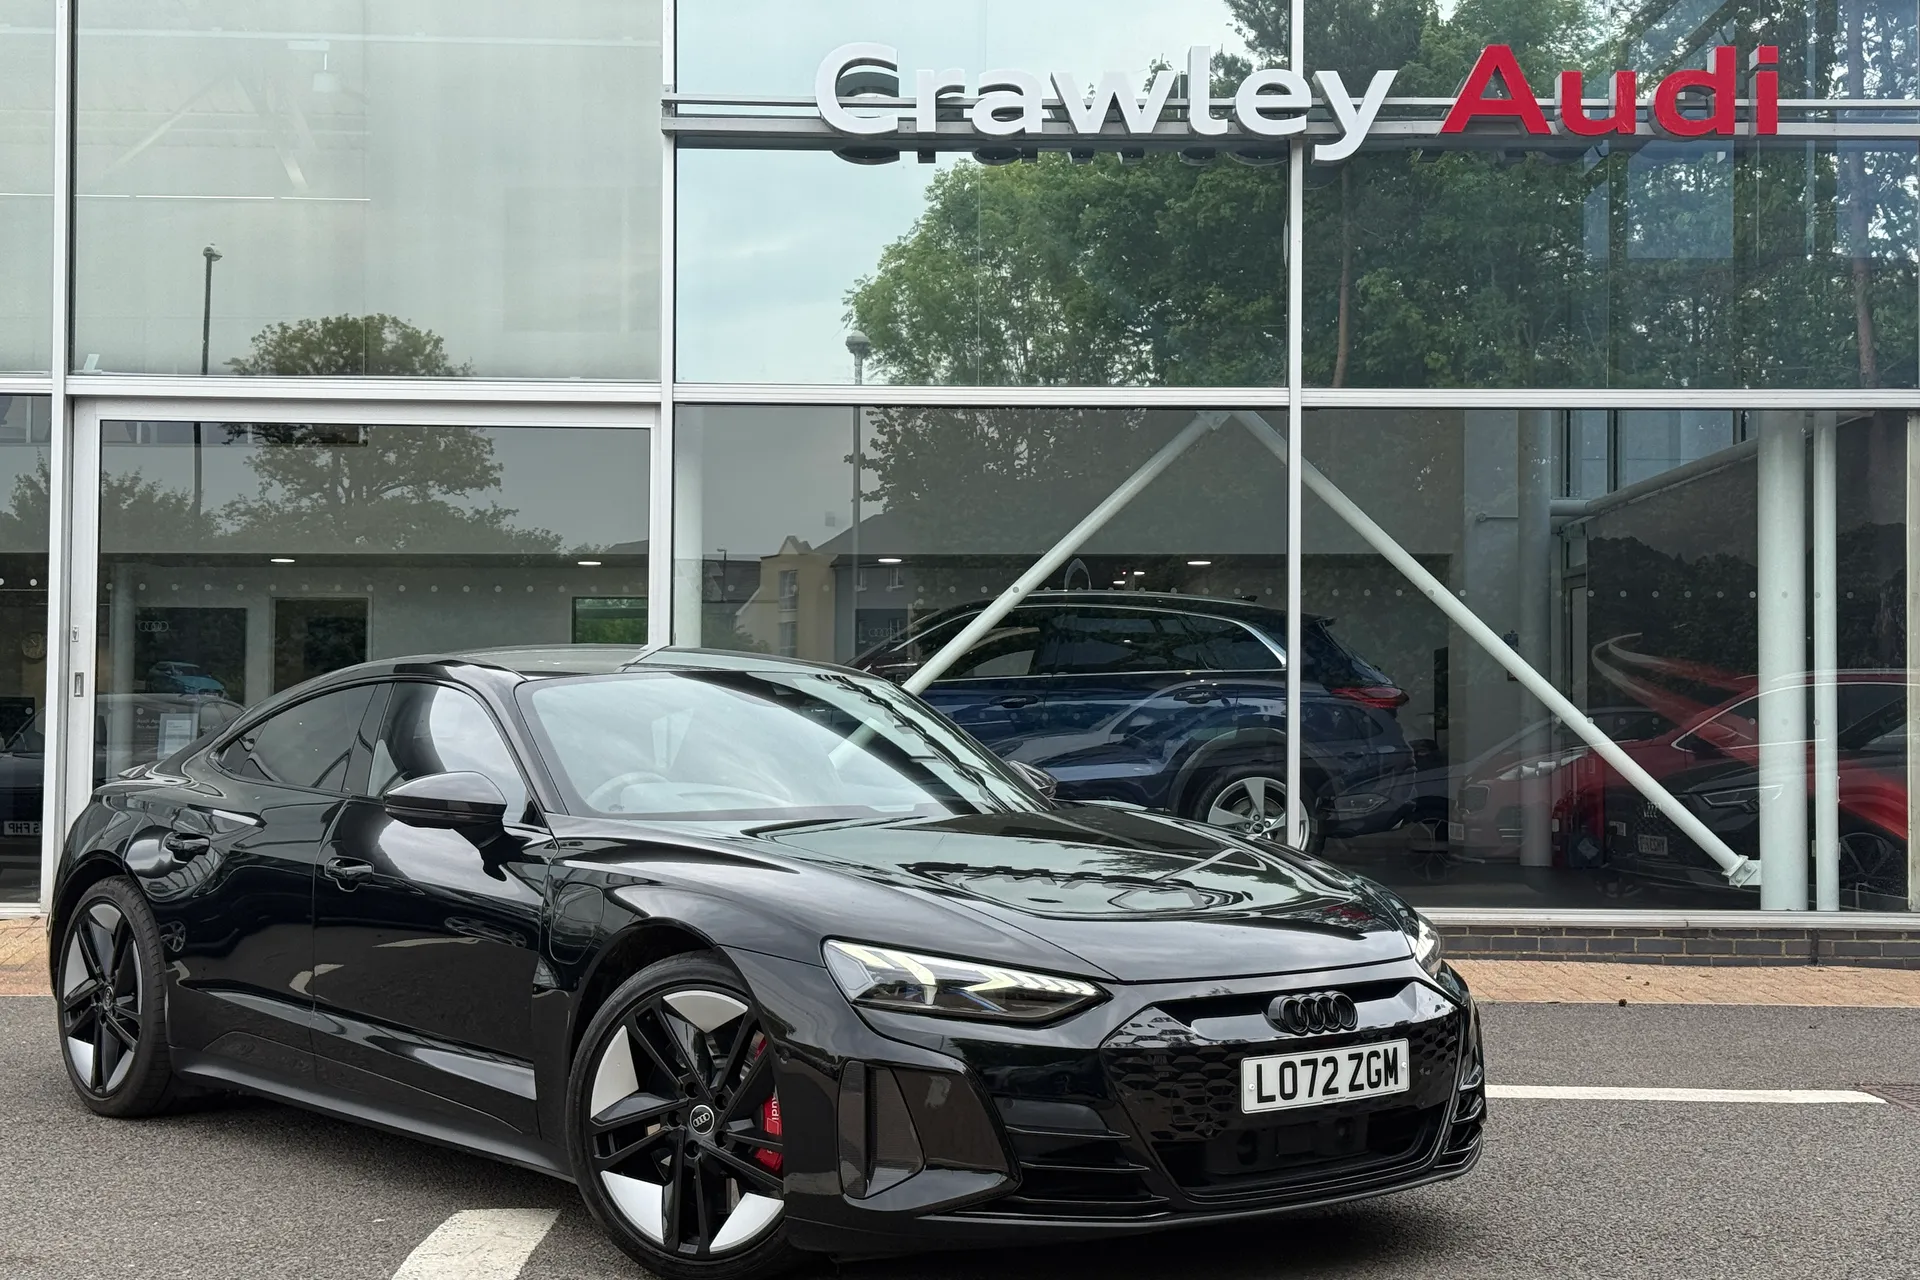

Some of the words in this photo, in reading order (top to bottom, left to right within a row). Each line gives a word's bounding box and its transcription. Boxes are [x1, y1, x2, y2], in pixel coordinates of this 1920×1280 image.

[815, 41, 1399, 163] Crawley
[1441, 43, 1779, 137] Audi
[1256, 1055, 1340, 1104] LO72
[1347, 1046, 1399, 1093] ZGM
